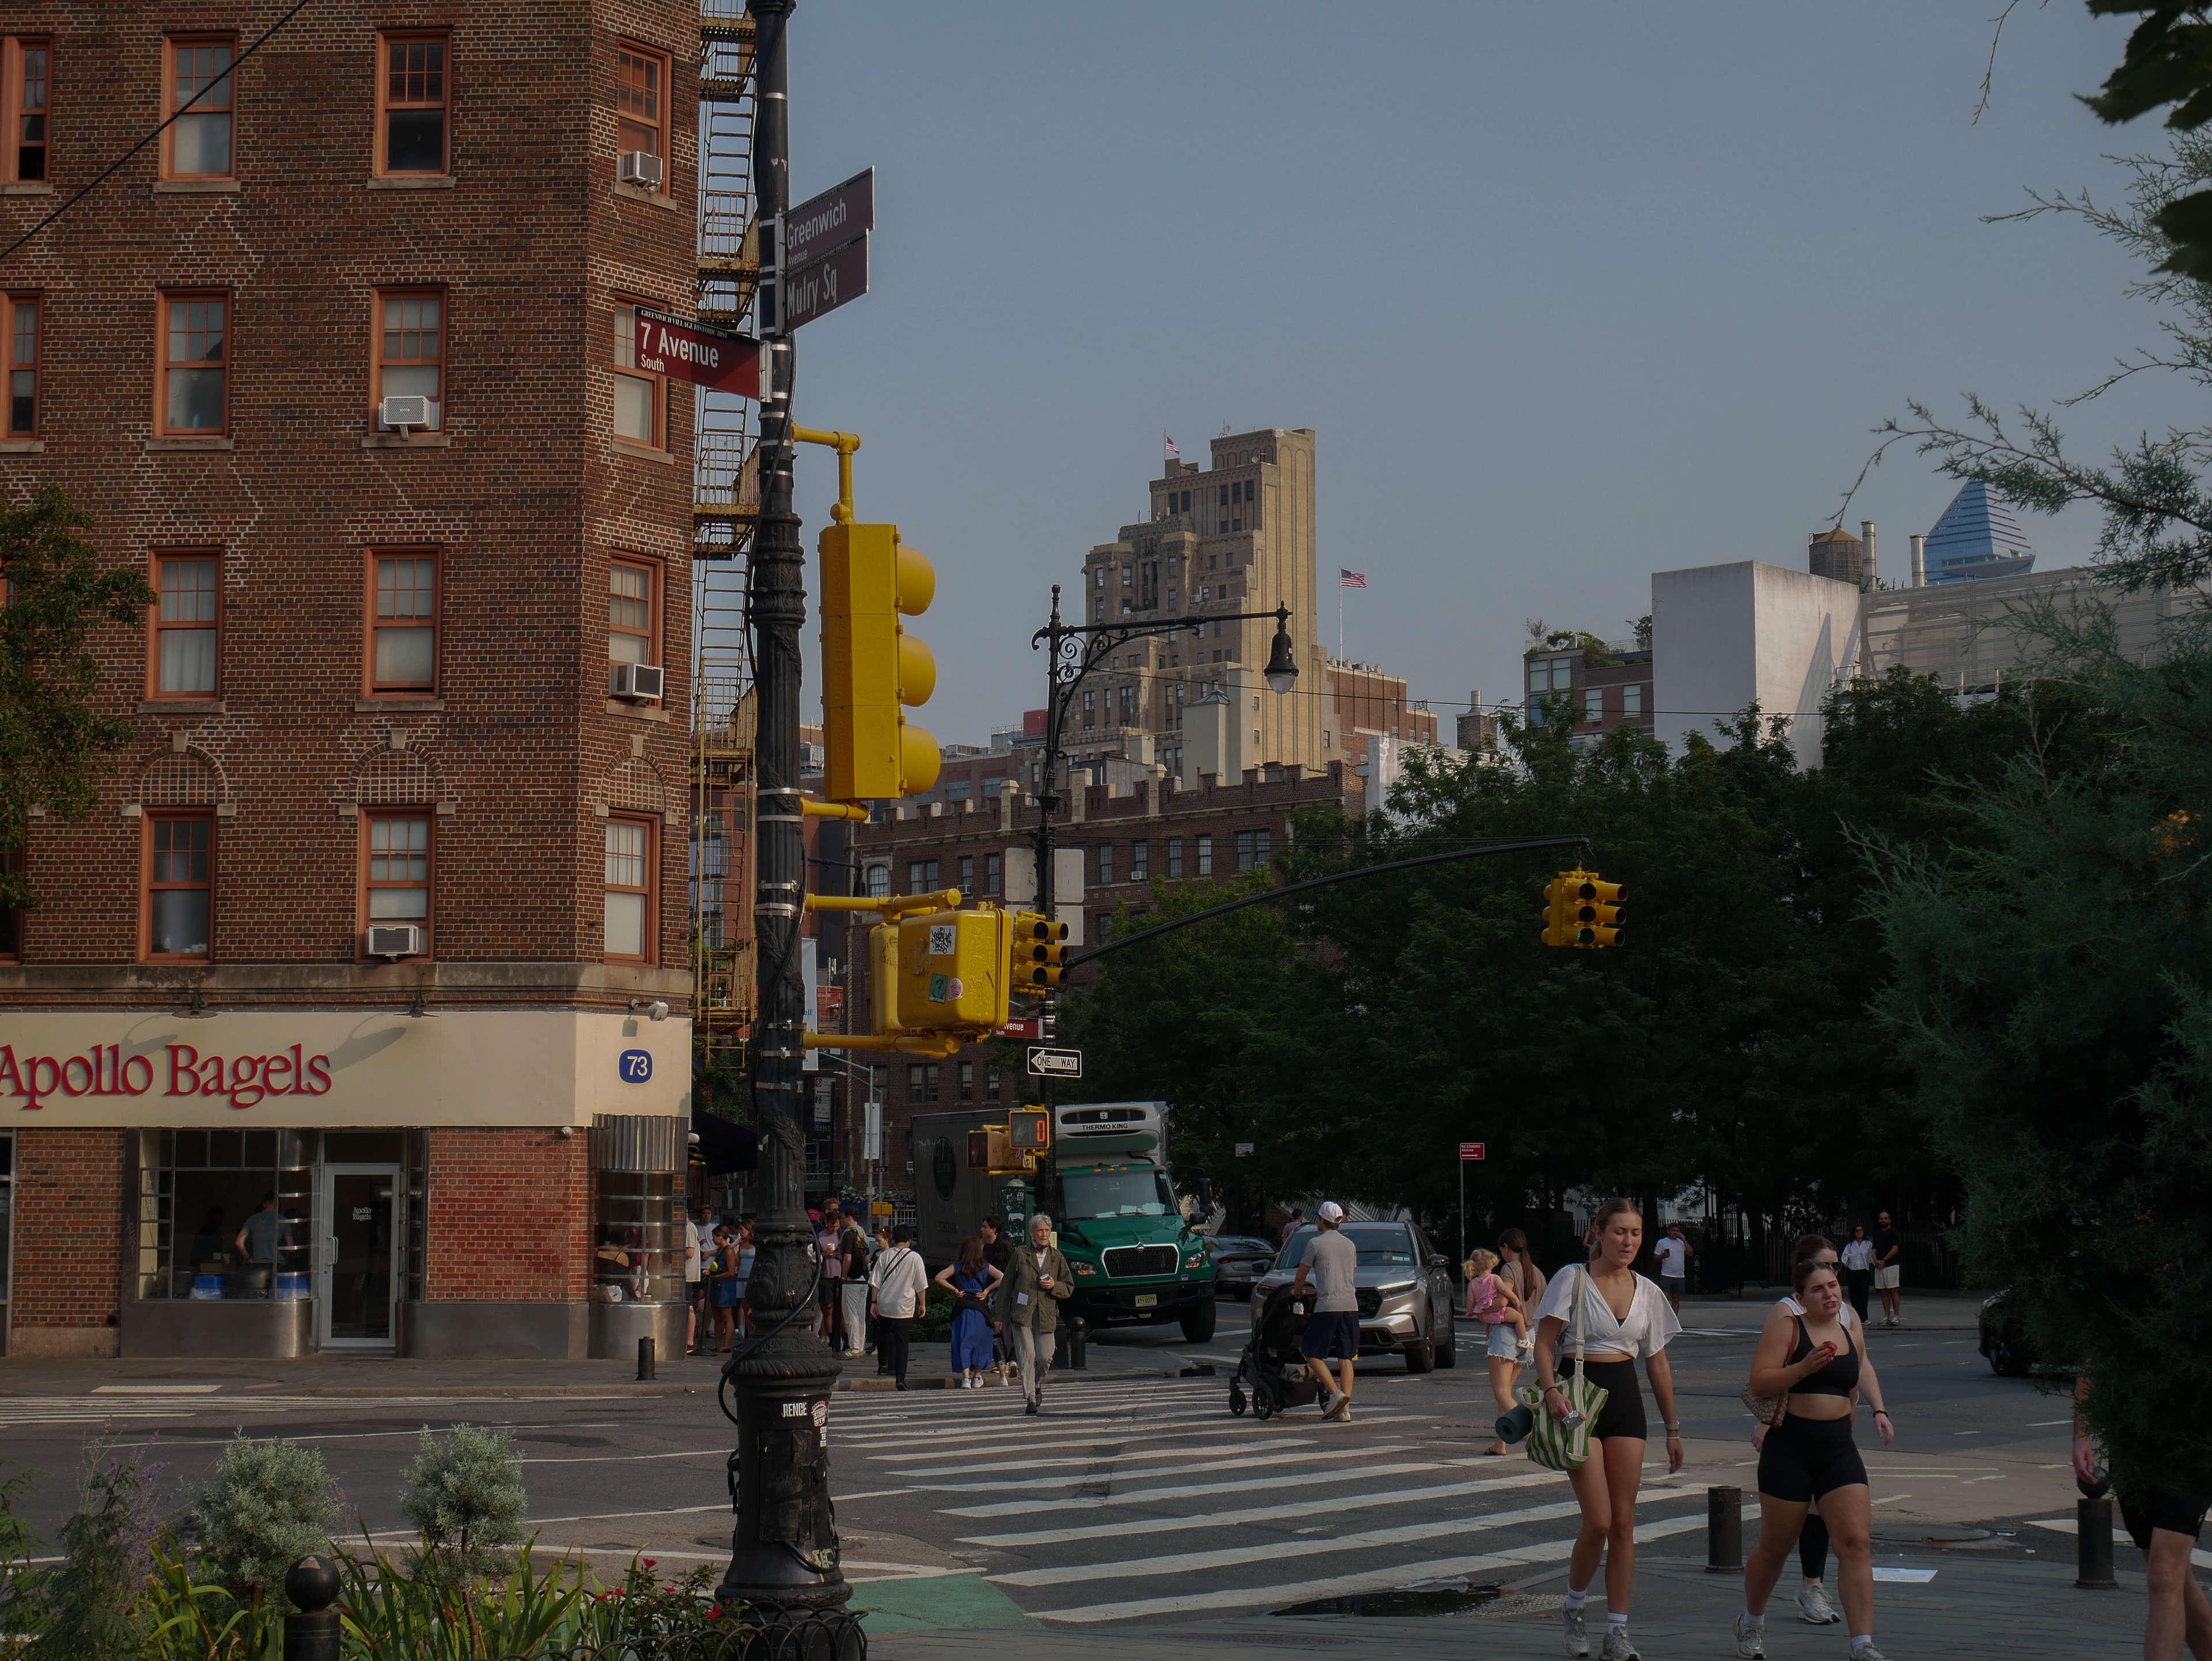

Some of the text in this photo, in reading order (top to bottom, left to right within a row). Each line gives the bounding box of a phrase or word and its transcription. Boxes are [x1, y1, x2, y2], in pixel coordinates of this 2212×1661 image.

[787, 197, 847, 250] Greenwich
[787, 249, 808, 268] Avenue
[787, 263, 838, 319] Mulry Sq
[641, 309, 728, 339] GREENWICH VILLAGE HISTORIC DIST
[641, 321, 719, 369] 7 Avenue
[641, 353, 665, 373] South
[627, 1055, 649, 1077] 73
[1037, 1056, 1075, 1069] ONE WAY
[0, 1043, 332, 1110] Apollo Bagels
[353, 1207, 372, 1215] Apollo
